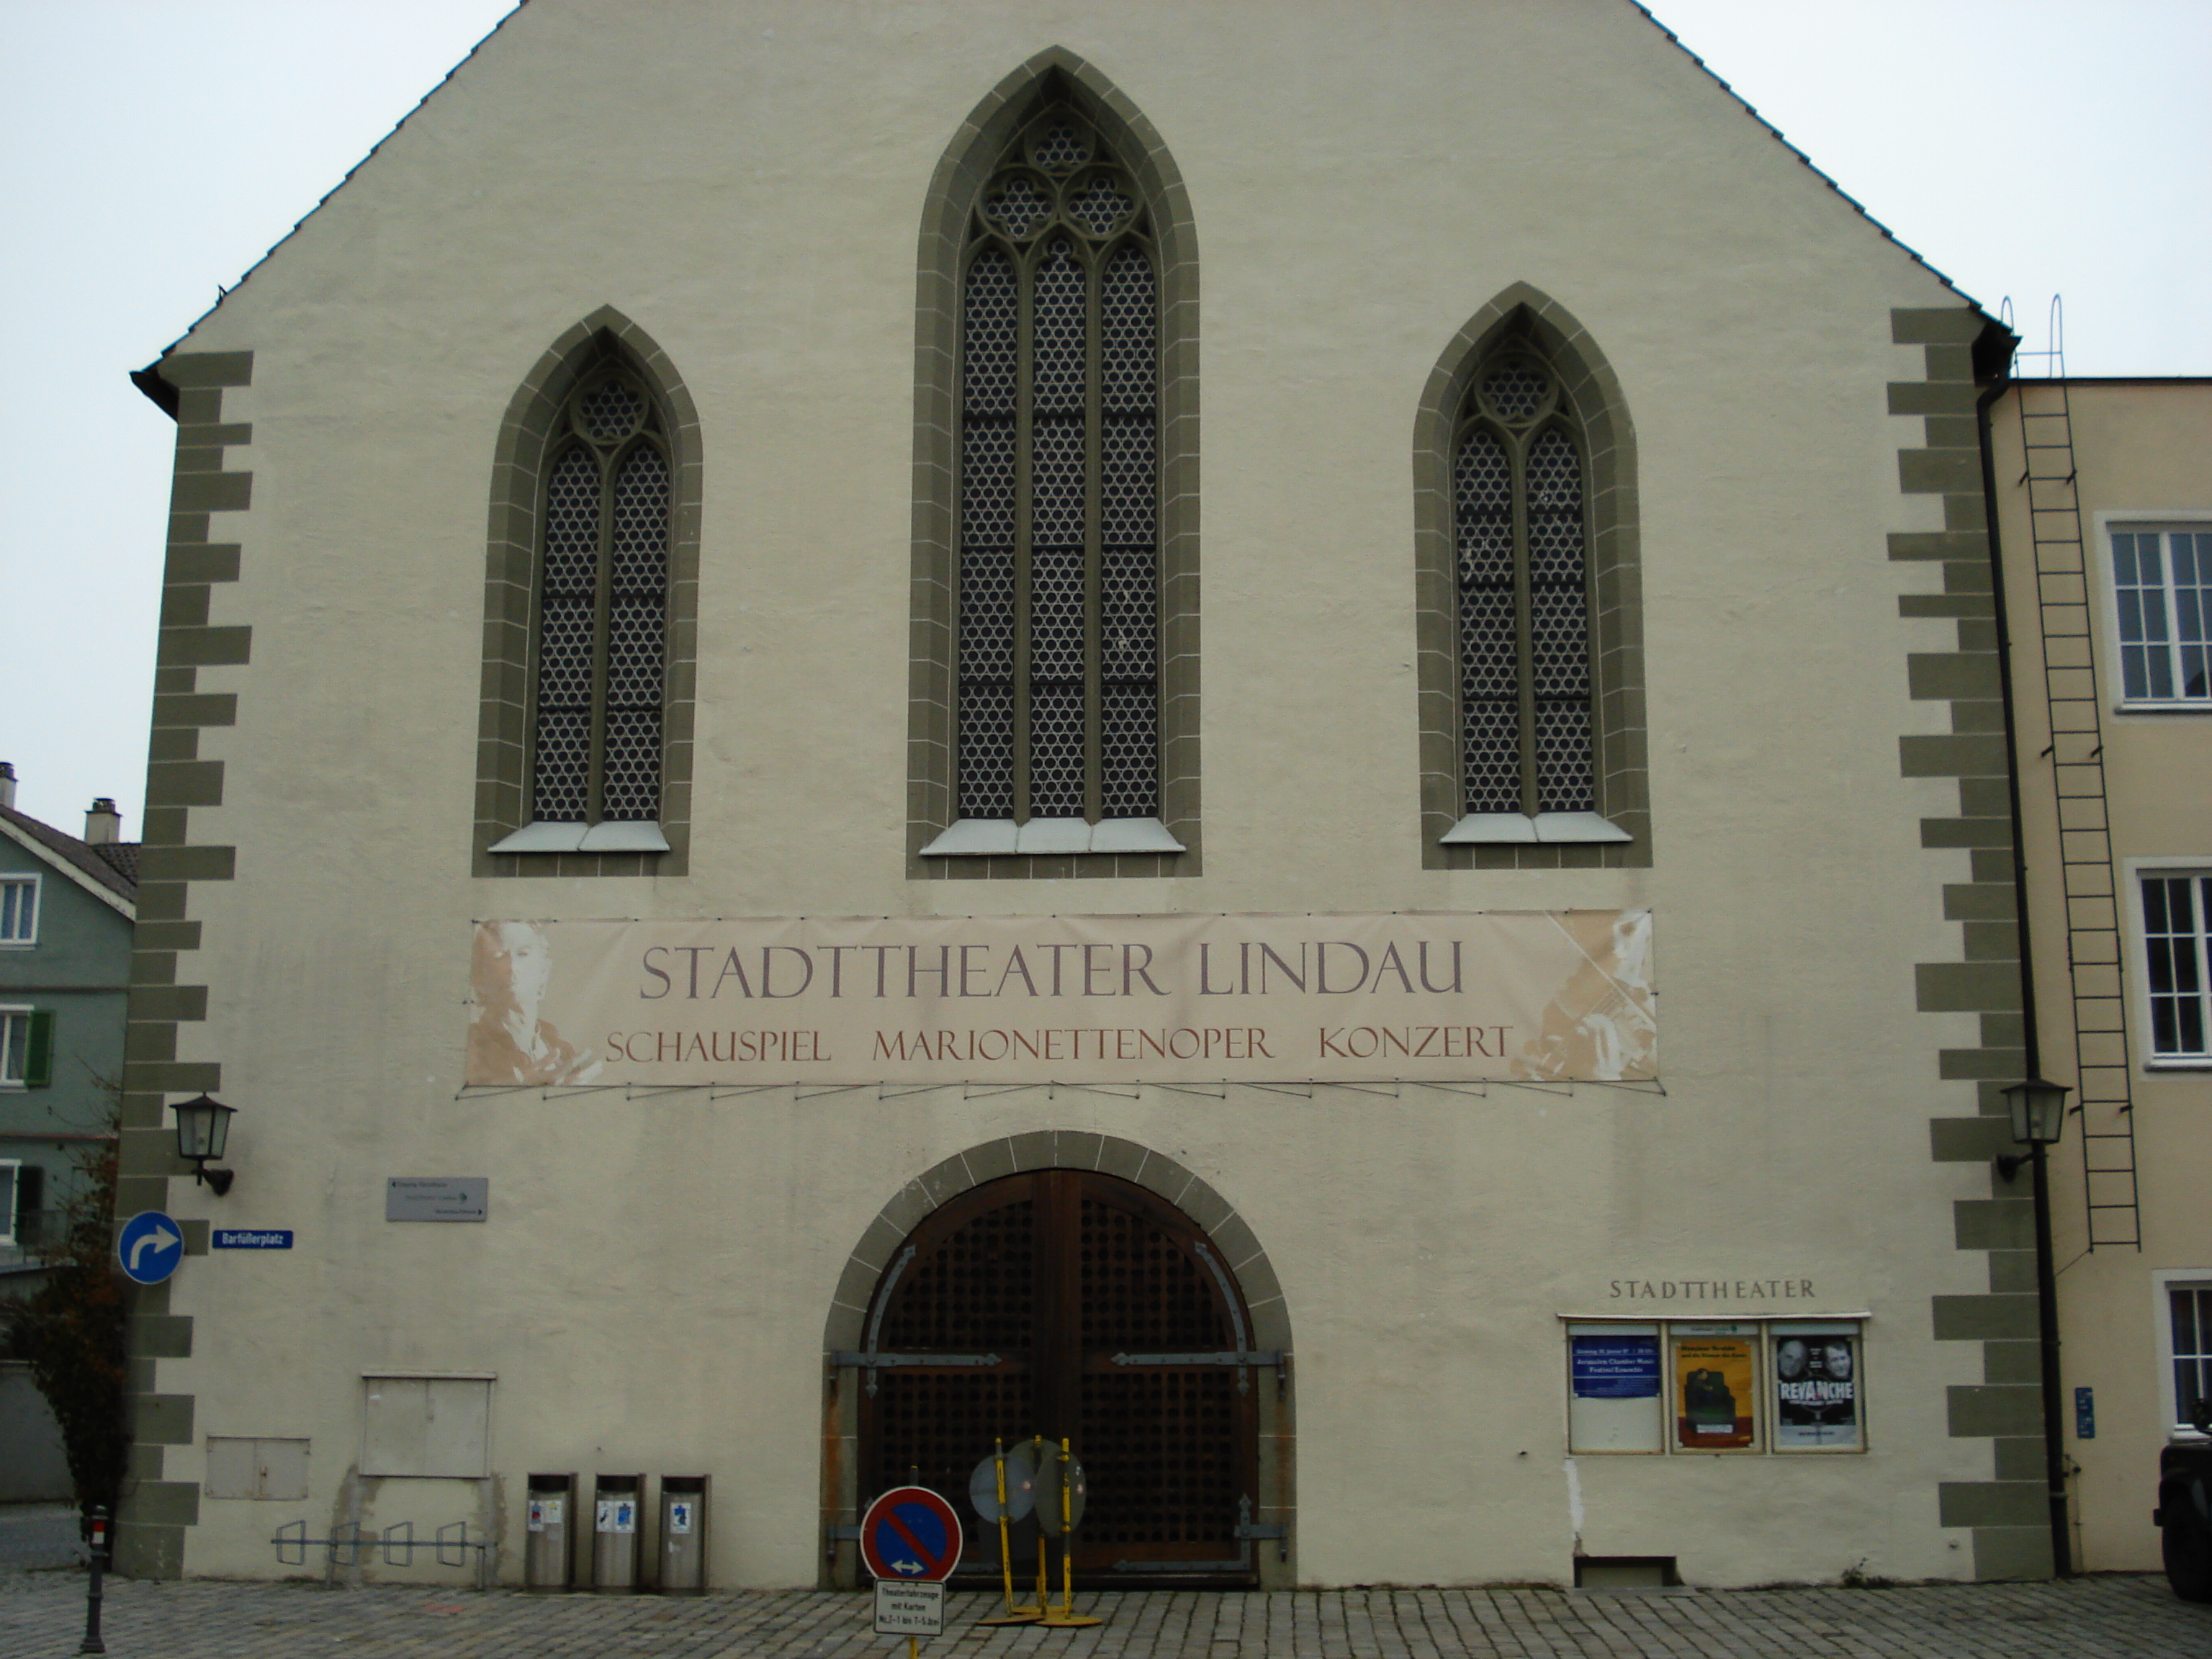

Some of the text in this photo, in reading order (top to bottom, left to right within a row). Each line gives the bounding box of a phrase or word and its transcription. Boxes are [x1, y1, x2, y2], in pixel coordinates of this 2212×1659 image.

[640, 940, 1465, 999] STADTTHEATER LINDAU
[606, 1025, 1514, 1063] SCHAUSPIEL MARIONETTENOPER KONZERT
[222, 1232, 284, 1247] Barfüßerplatz
[1609, 1280, 1815, 1298] STADTTHEATER
[1780, 1380, 1853, 1401] REVANCHE
